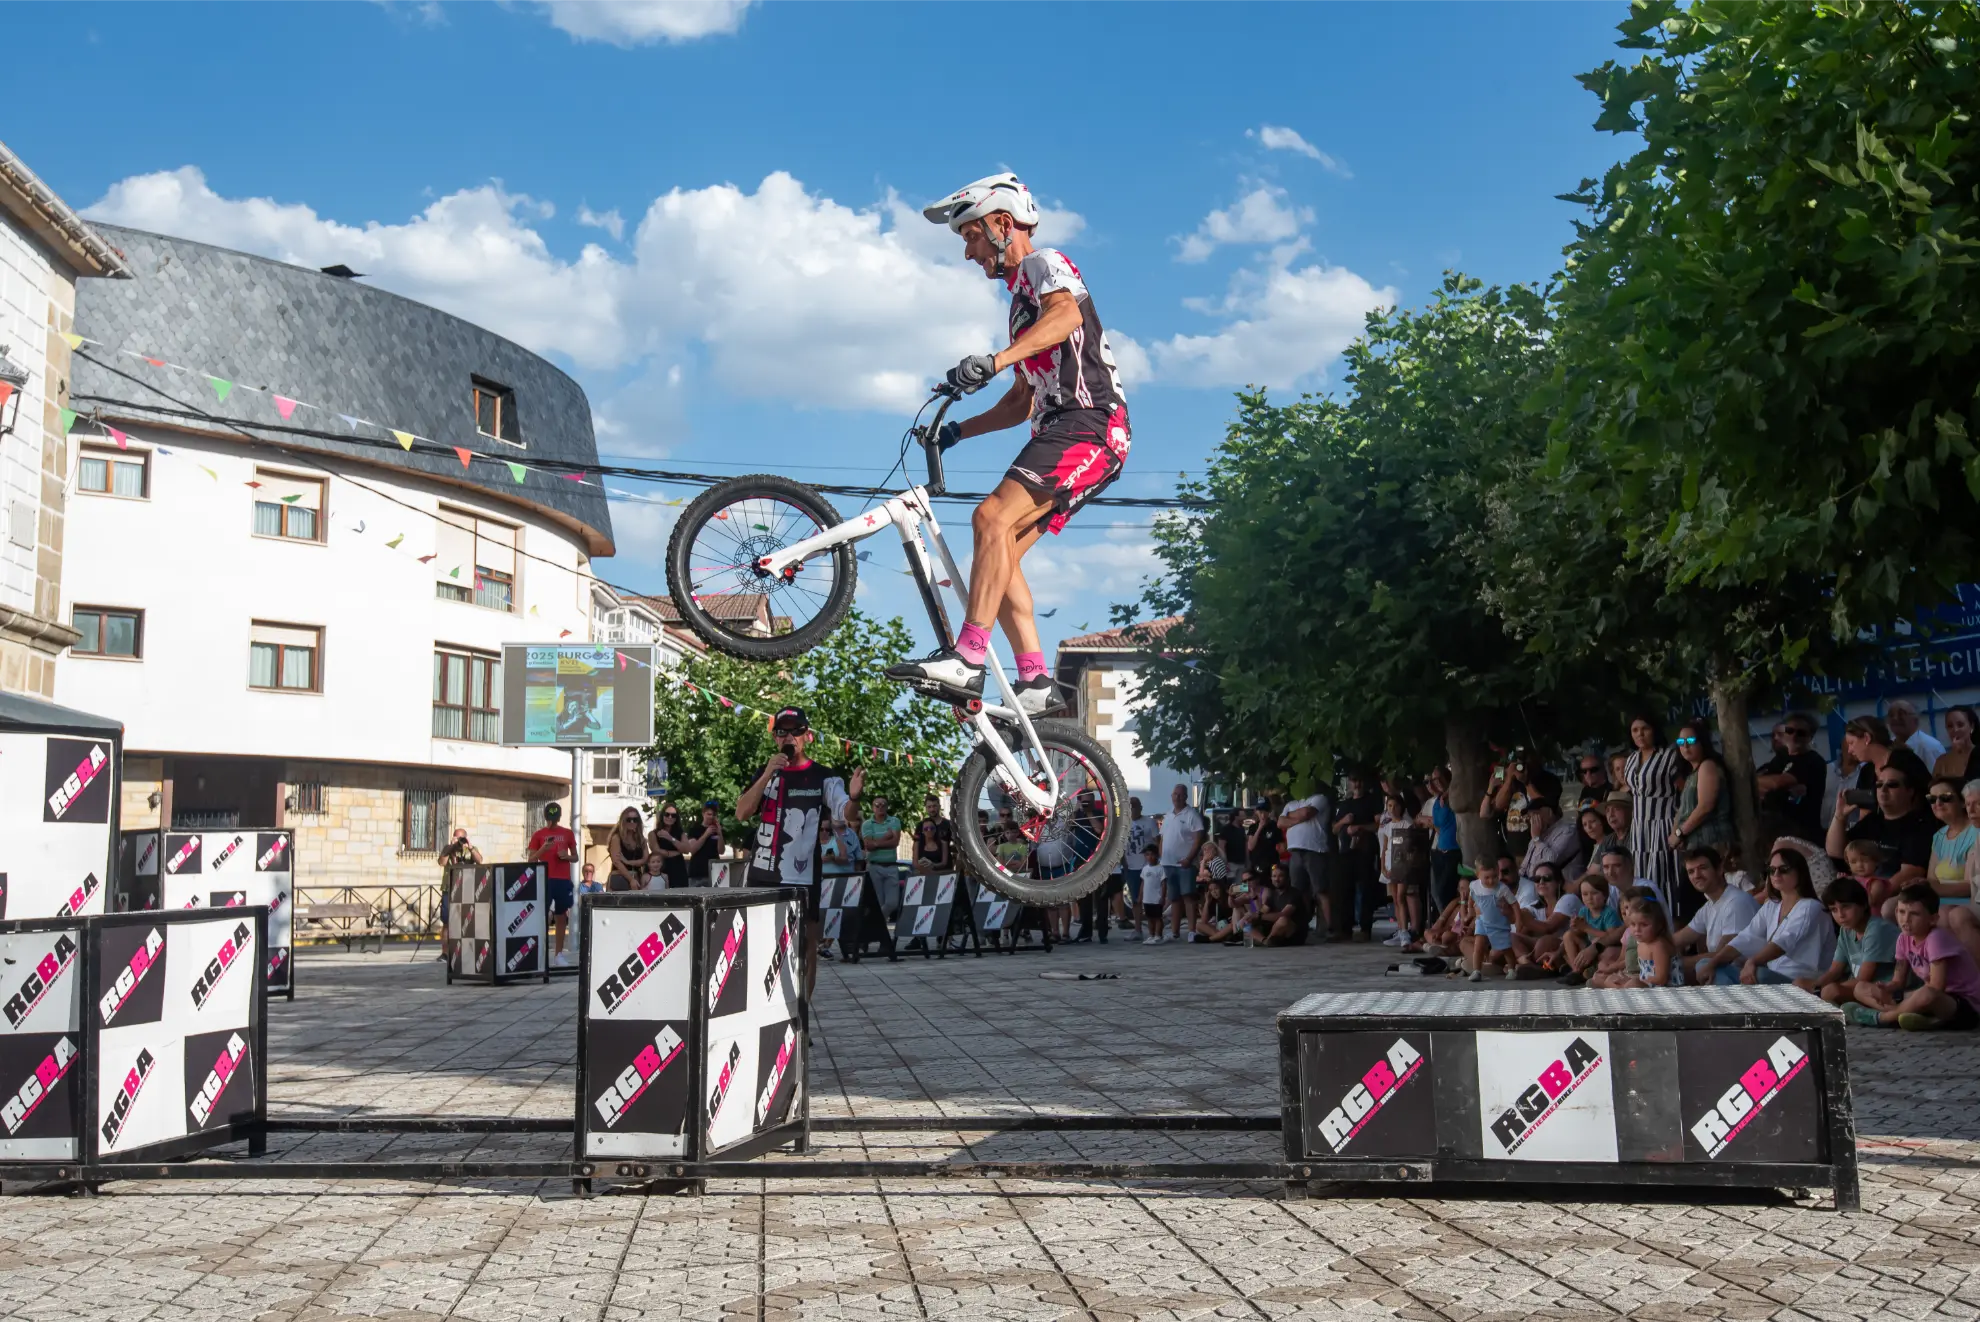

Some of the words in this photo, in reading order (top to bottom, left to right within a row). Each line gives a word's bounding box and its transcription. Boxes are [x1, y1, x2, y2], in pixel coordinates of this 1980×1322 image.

[48, 744, 106, 816] RGBA
[56, 871, 99, 917] GBA
[167, 835, 201, 874] RGBA
[212, 835, 244, 870] RGBA
[191, 922, 250, 1007] RGBA
[507, 902, 535, 935] RGBA
[597, 912, 686, 1010] RGBA
[709, 909, 745, 1010] RGBA
[2, 933, 77, 1026] RGBA
[99, 927, 164, 1021] RGBA
[0, 1035, 78, 1130] RGBA
[101, 1047, 154, 1144] RGBA
[189, 1032, 246, 1125] RGBA
[594, 1024, 683, 1123] RGBA
[757, 1023, 795, 1123] RGBA
[1317, 1037, 1420, 1148] RGBA
[1490, 1036, 1599, 1149] RGBA
[1507, 1055, 1603, 1156] RAULGUTIERREZBIKEACADEMY
[1690, 1035, 1806, 1153] RGBA
